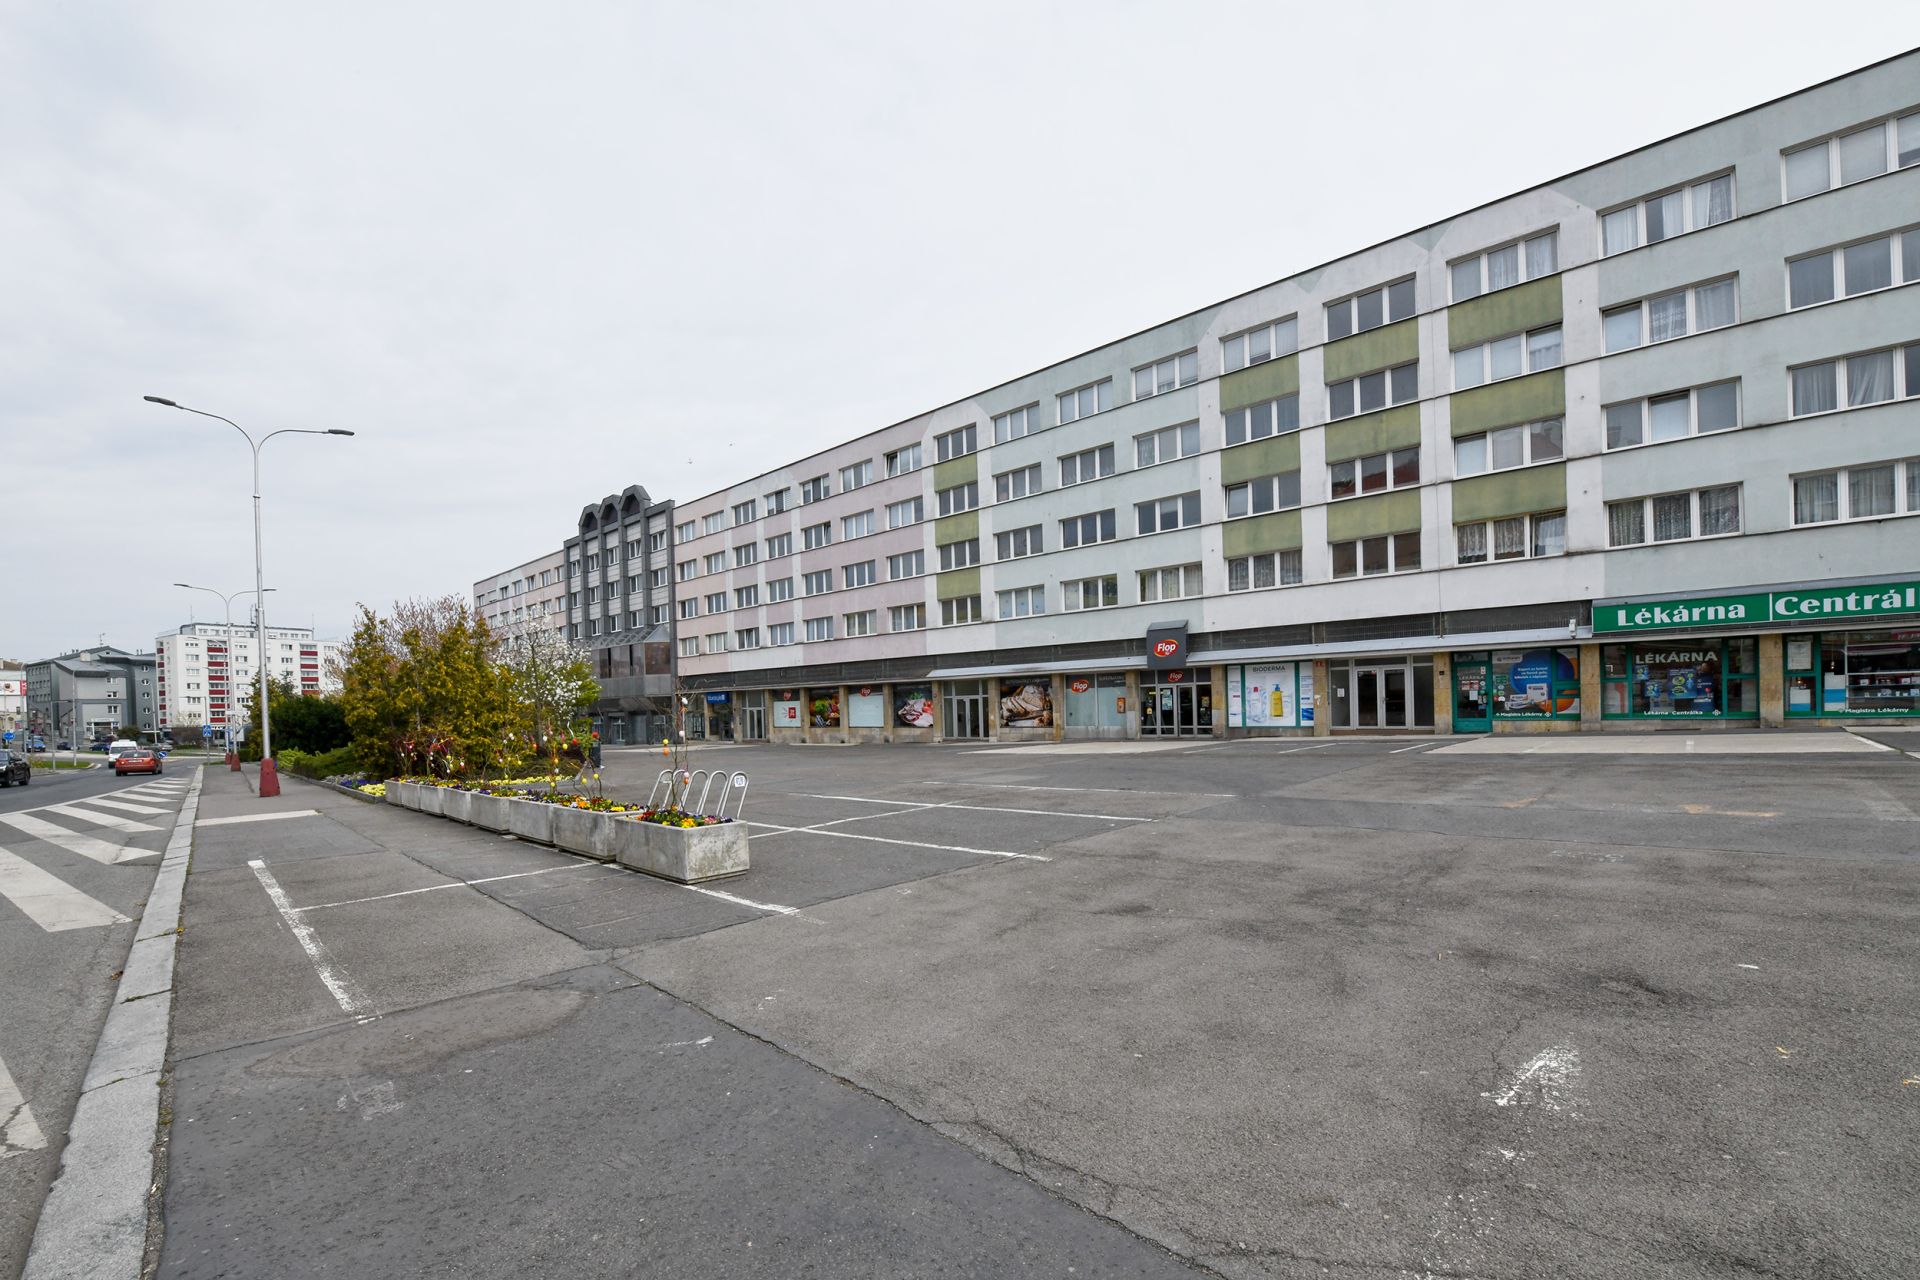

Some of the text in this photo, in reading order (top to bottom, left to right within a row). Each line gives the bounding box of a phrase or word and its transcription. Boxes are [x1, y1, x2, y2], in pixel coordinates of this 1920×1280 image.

[1617, 587, 1920, 626] Lékárna Centrál
[1157, 642, 1176, 653] Flop
[1635, 651, 1718, 664] LÉKÁRNA
[1169, 672, 1183, 680] Flop
[1073, 682, 1088, 691] Flop
